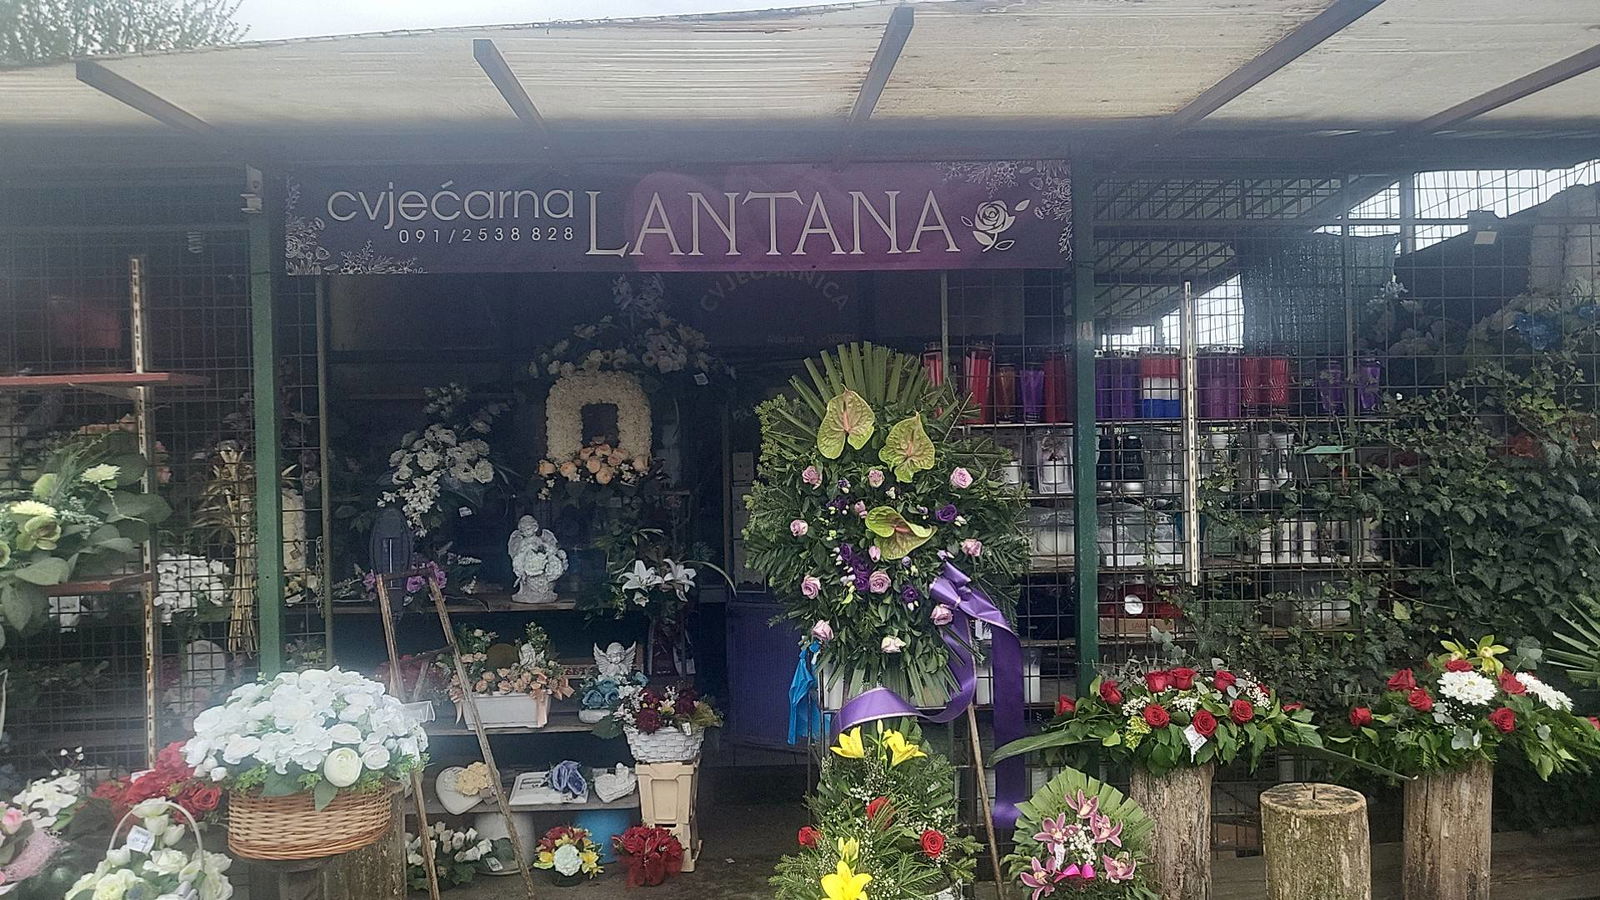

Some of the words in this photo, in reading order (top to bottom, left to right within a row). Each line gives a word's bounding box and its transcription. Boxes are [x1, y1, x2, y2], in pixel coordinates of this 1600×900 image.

[327, 180, 574, 230] cvjećarna
[584, 189, 961, 258] LANTANA
[398, 227, 521, 244] 091/2538
[531, 226, 574, 242] 828
